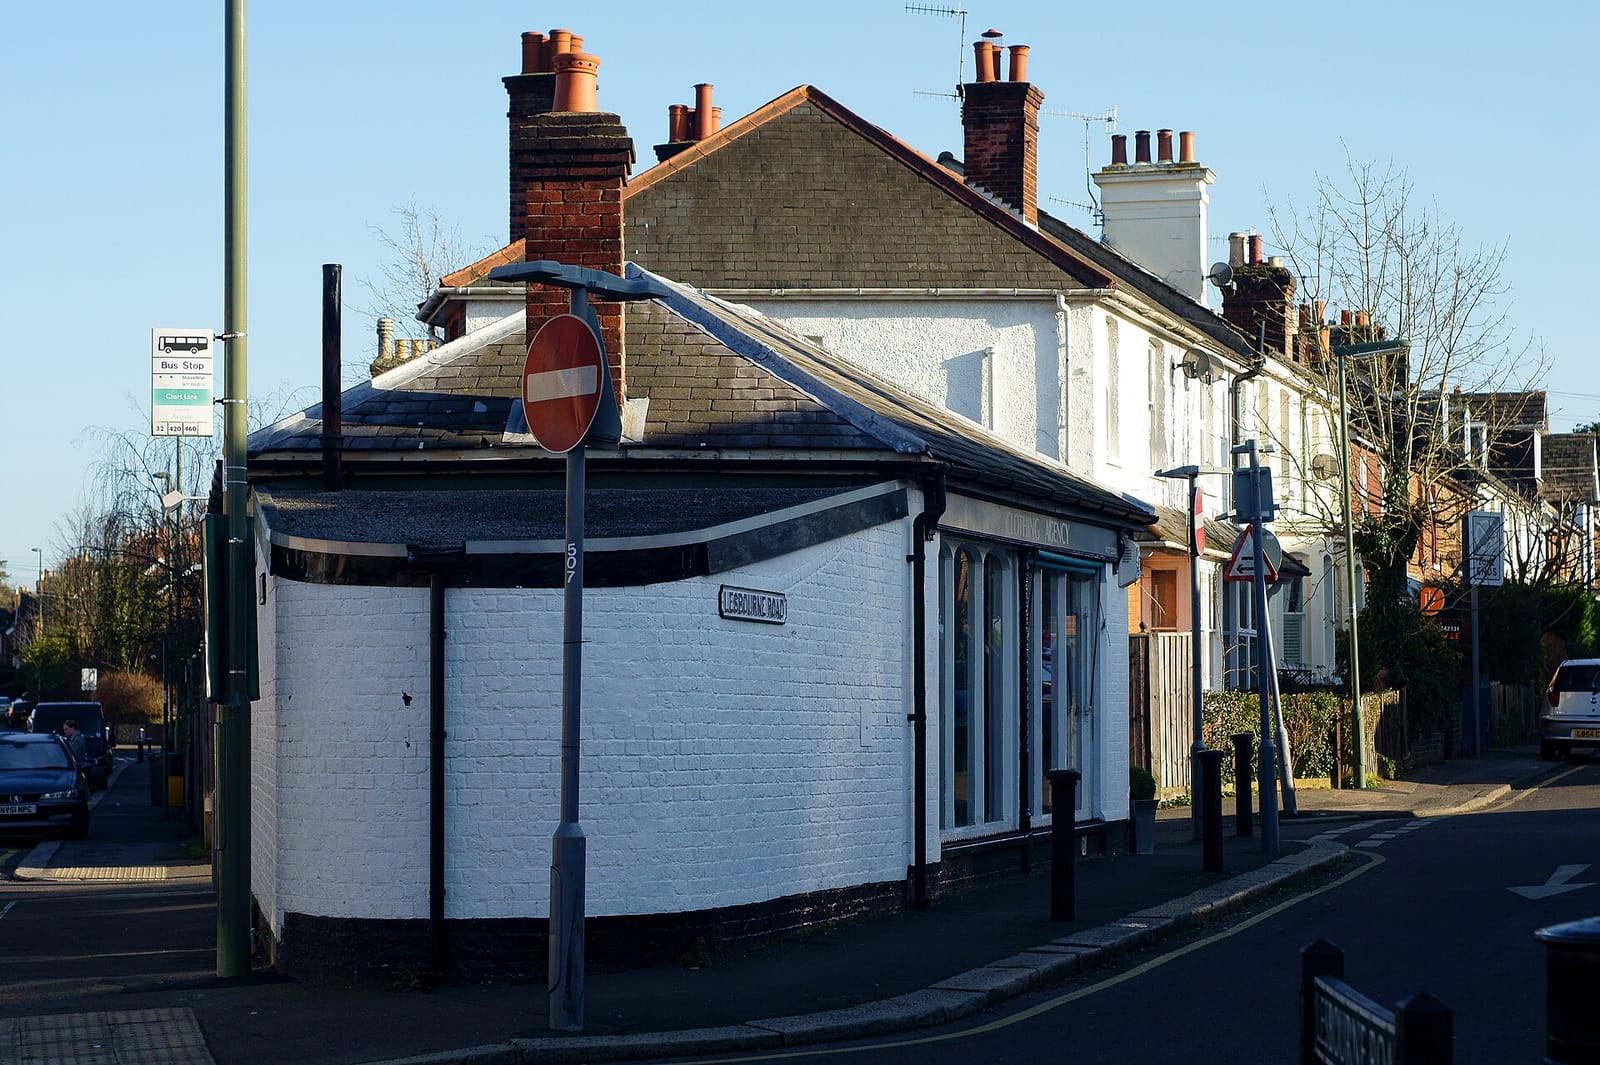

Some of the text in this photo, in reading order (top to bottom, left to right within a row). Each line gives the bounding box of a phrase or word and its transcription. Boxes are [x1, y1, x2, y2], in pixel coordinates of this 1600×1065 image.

[161, 361, 204, 371] Bus Stop
[1008, 512, 1070, 544] CLOTHING AGENCY
[567, 543, 577, 584] 507
[723, 591, 785, 619] LESBOURNE ROAD
